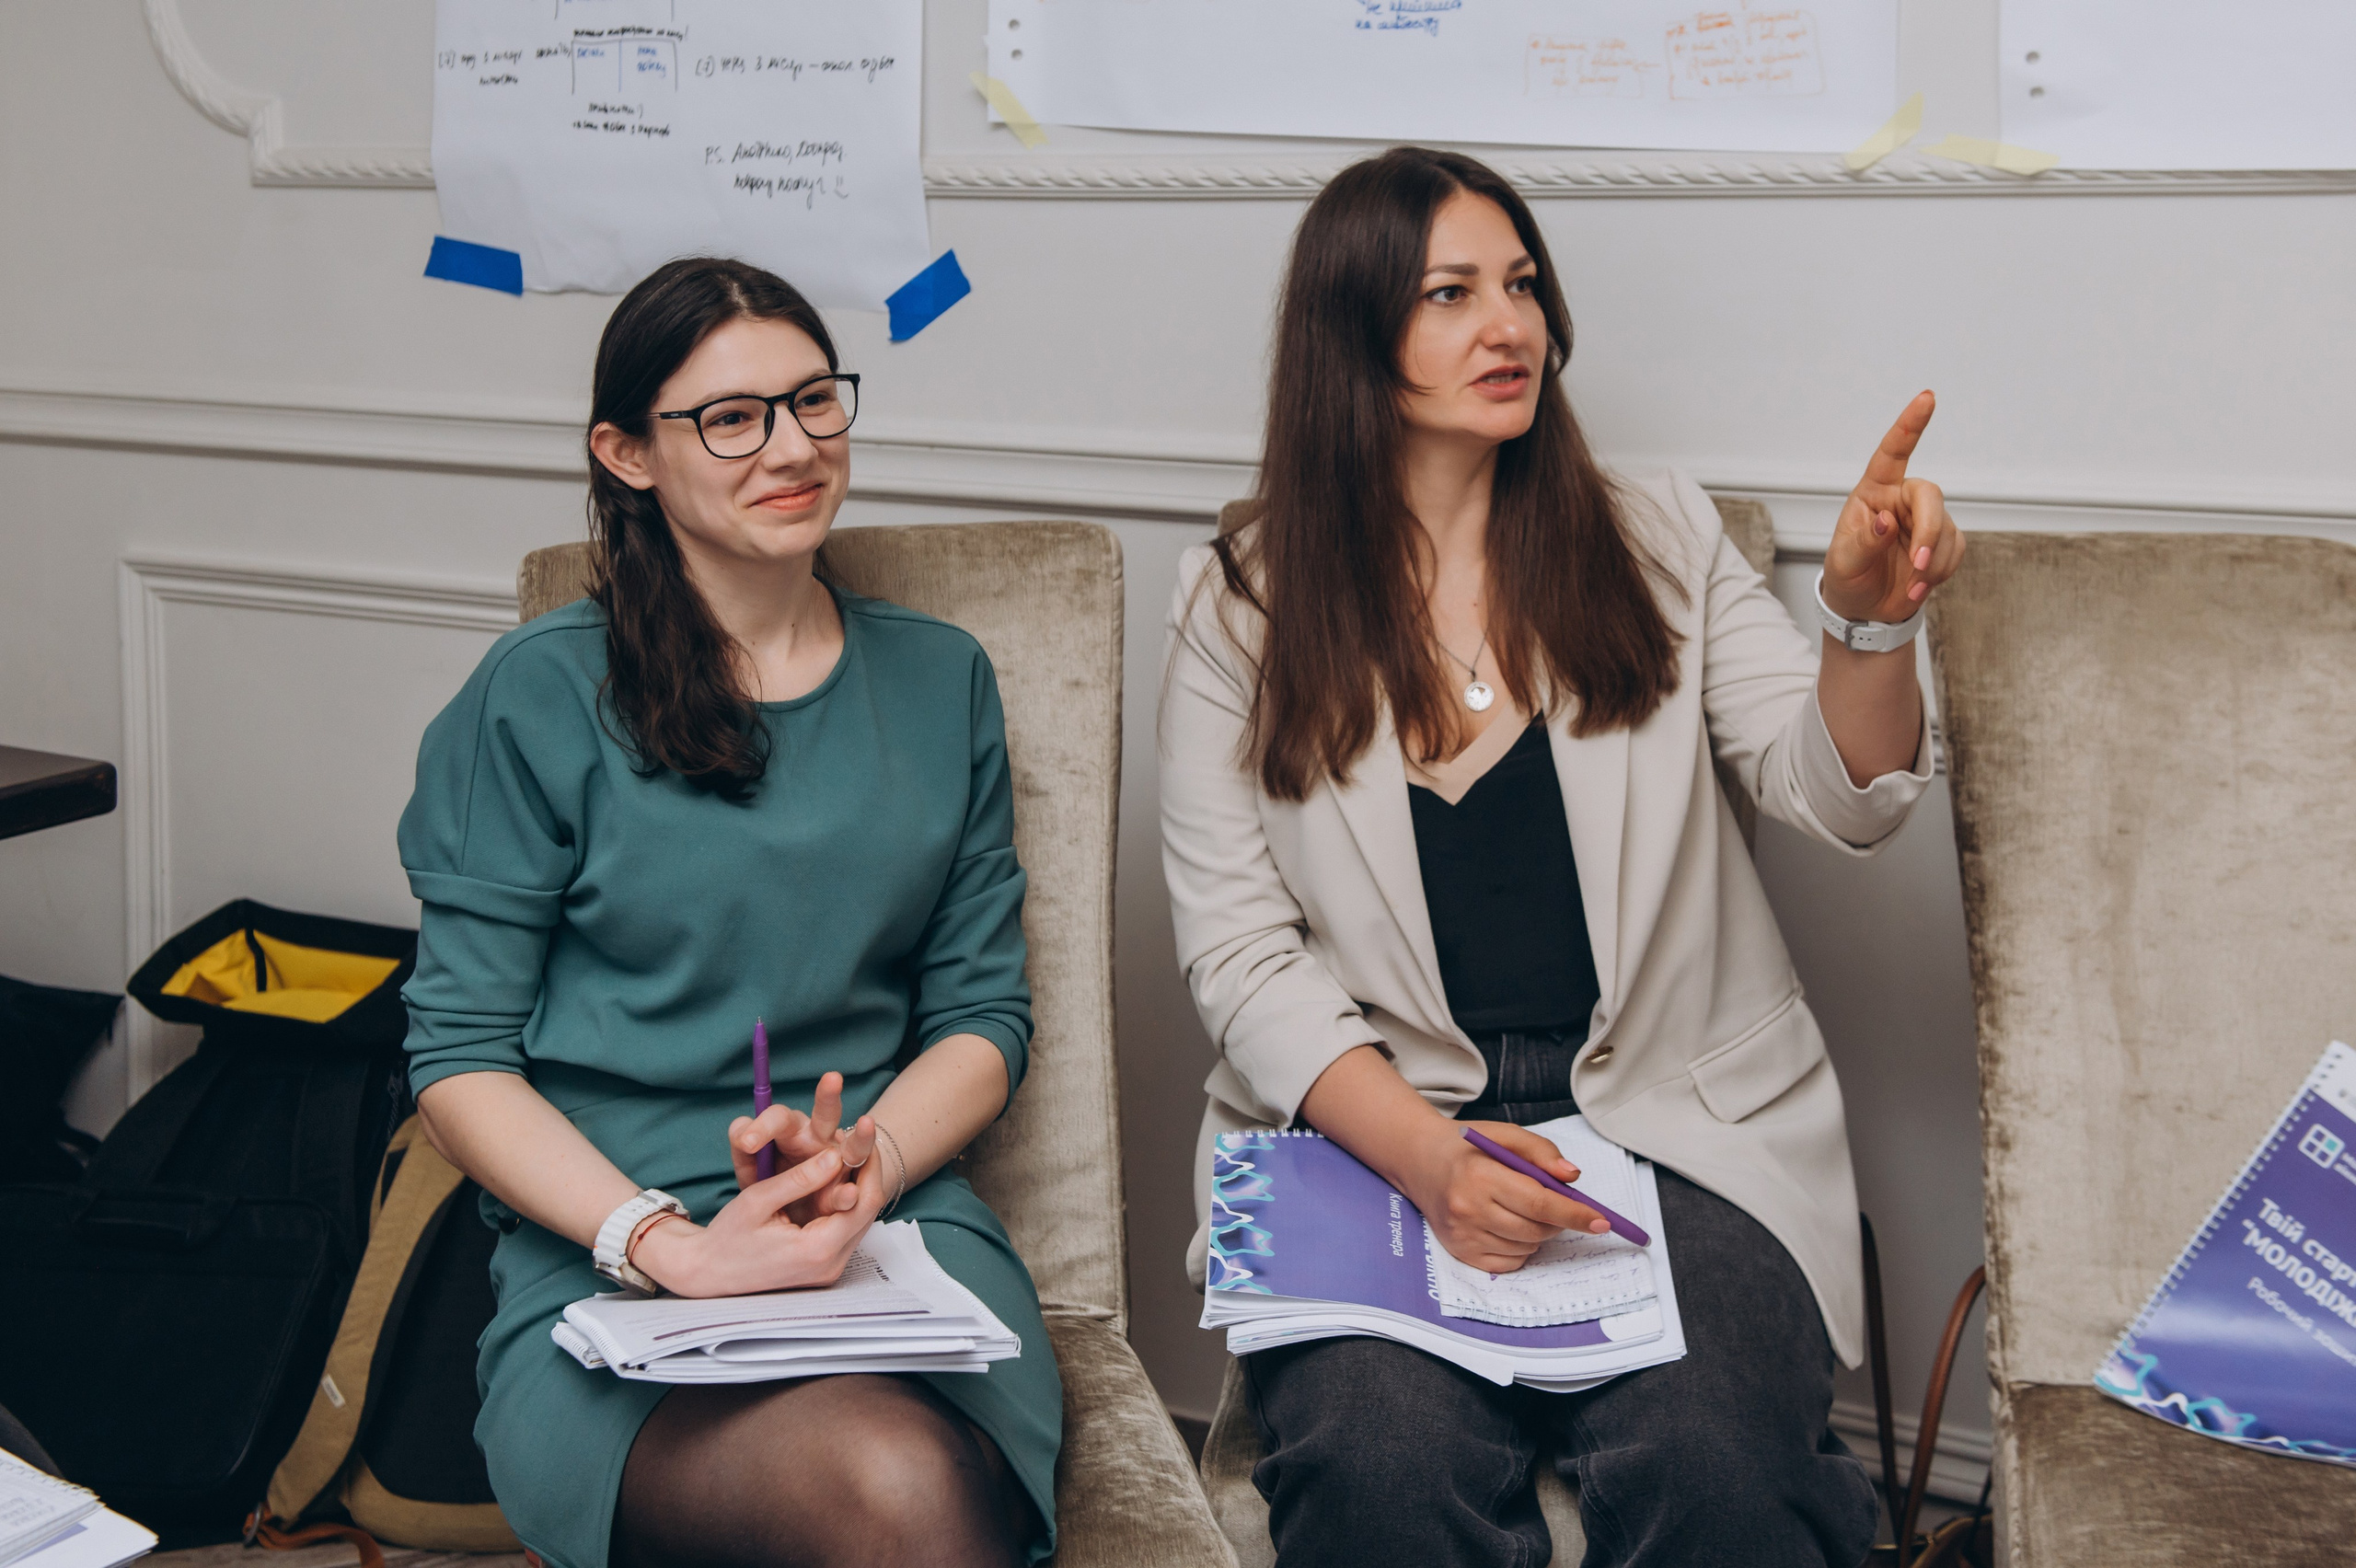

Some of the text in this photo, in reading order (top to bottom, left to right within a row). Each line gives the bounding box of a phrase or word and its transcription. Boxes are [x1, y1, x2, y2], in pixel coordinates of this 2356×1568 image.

[1388, 1192, 1404, 1258] Книга тренера
[2258, 1197, 2306, 1243] Твій
[2247, 1276, 2315, 1332] Робочий
